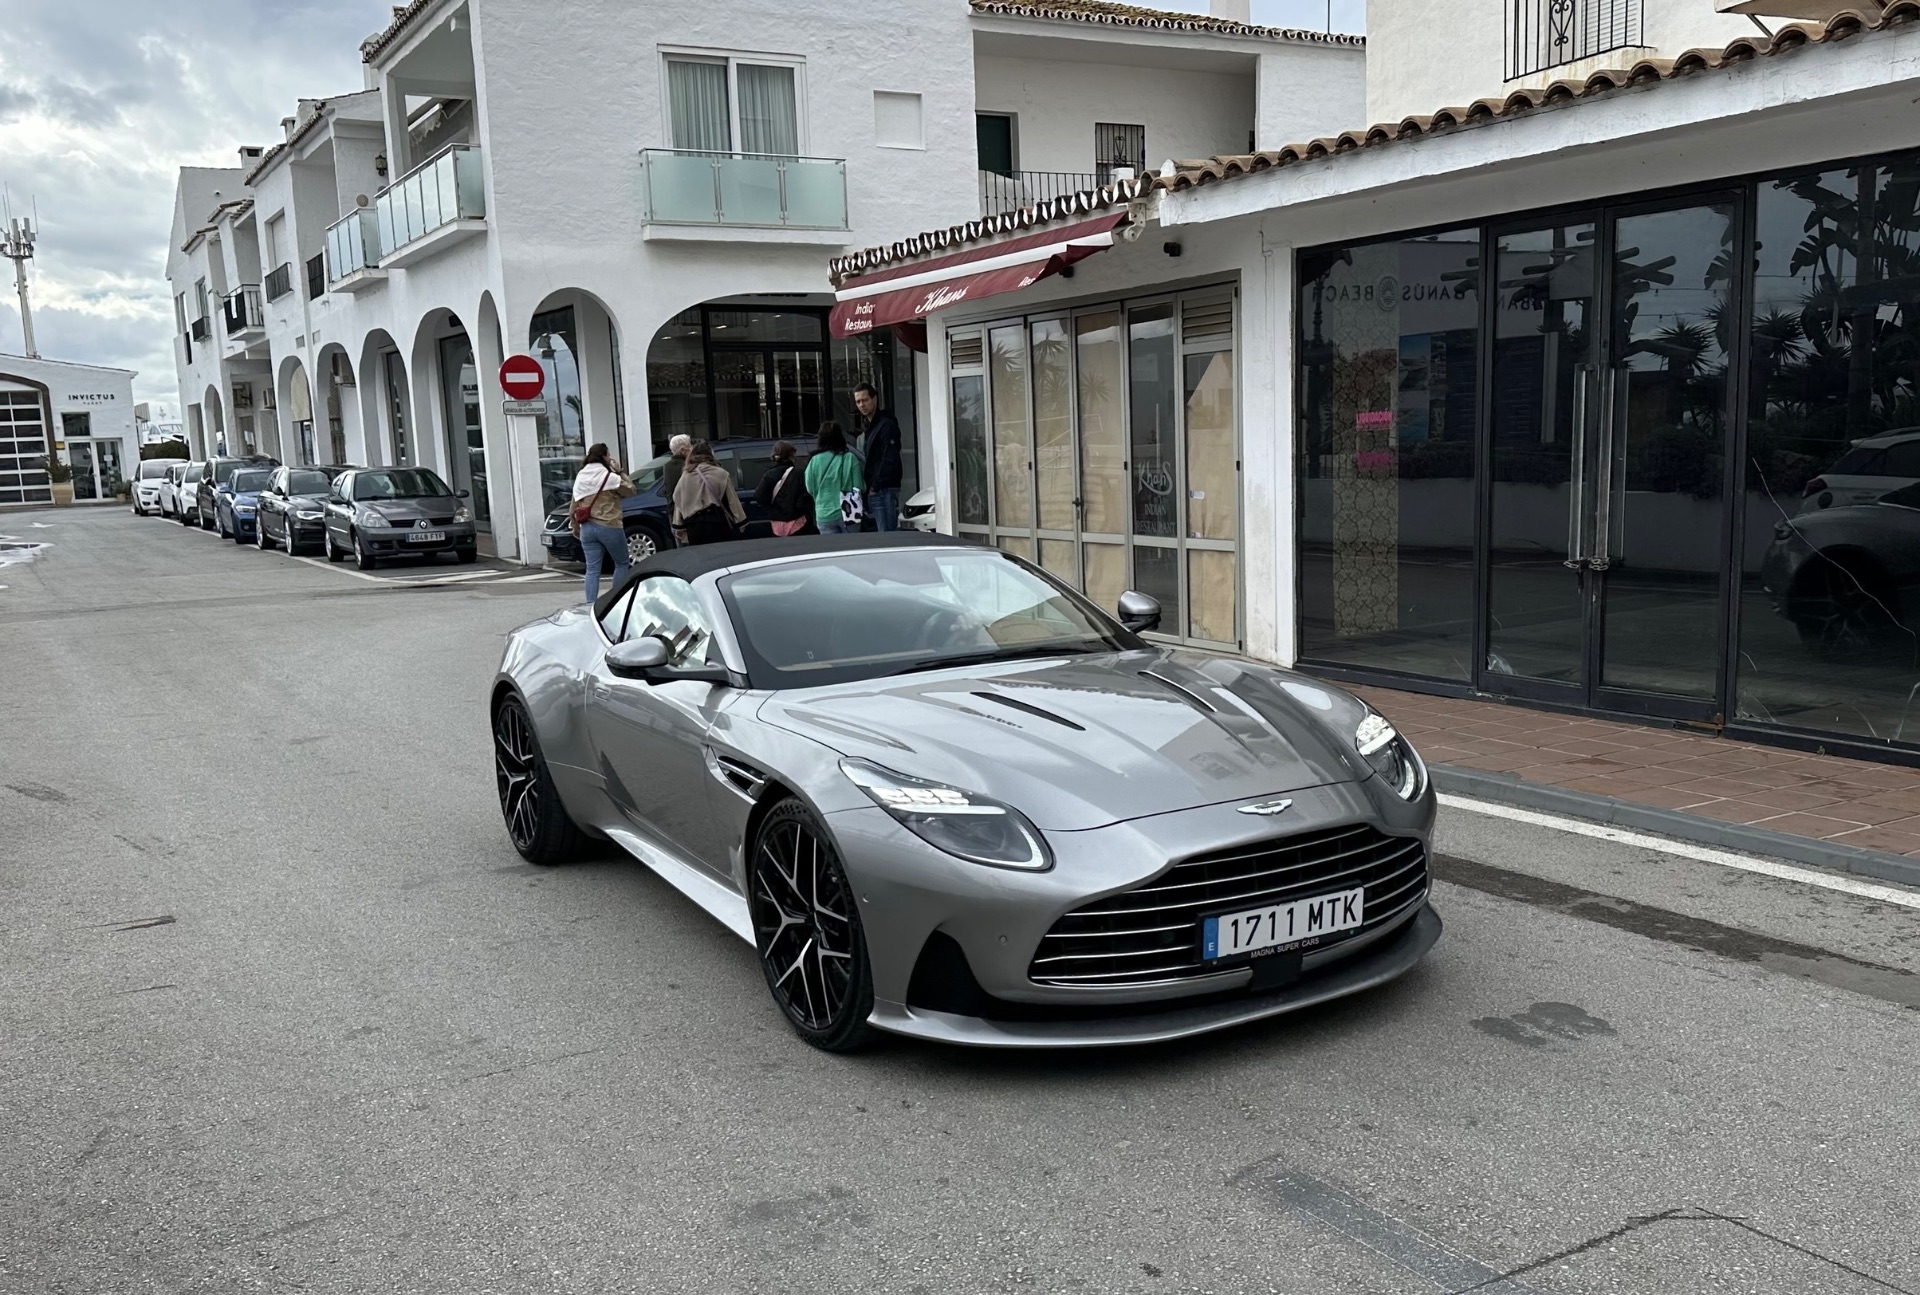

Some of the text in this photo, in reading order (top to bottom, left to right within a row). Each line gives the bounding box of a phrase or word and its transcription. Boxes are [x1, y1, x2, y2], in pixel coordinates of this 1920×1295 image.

[855, 301, 876, 315] India
[915, 286, 969, 314] Khans
[1231, 893, 1358, 949] 1711 MTK
[1208, 942, 1214, 951] E
[1251, 937, 1320, 959] MAGNA SUPER CARS
